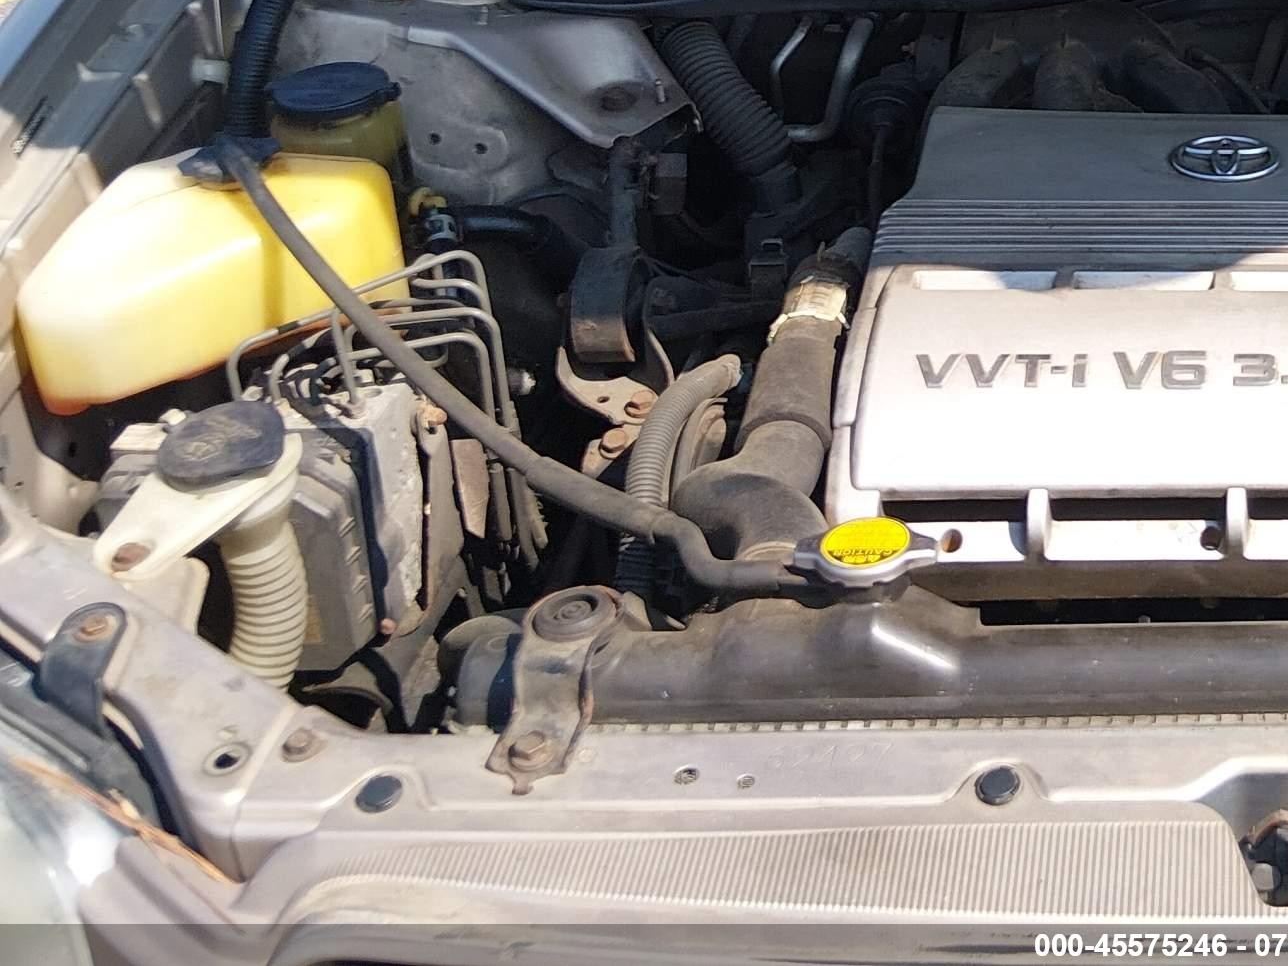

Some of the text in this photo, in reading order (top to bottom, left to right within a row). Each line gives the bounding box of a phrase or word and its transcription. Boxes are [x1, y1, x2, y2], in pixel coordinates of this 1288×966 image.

[916, 352, 1090, 389] VVT-i
[1112, 349, 1208, 390] V6
[832, 548, 894, 557] CAUTION
